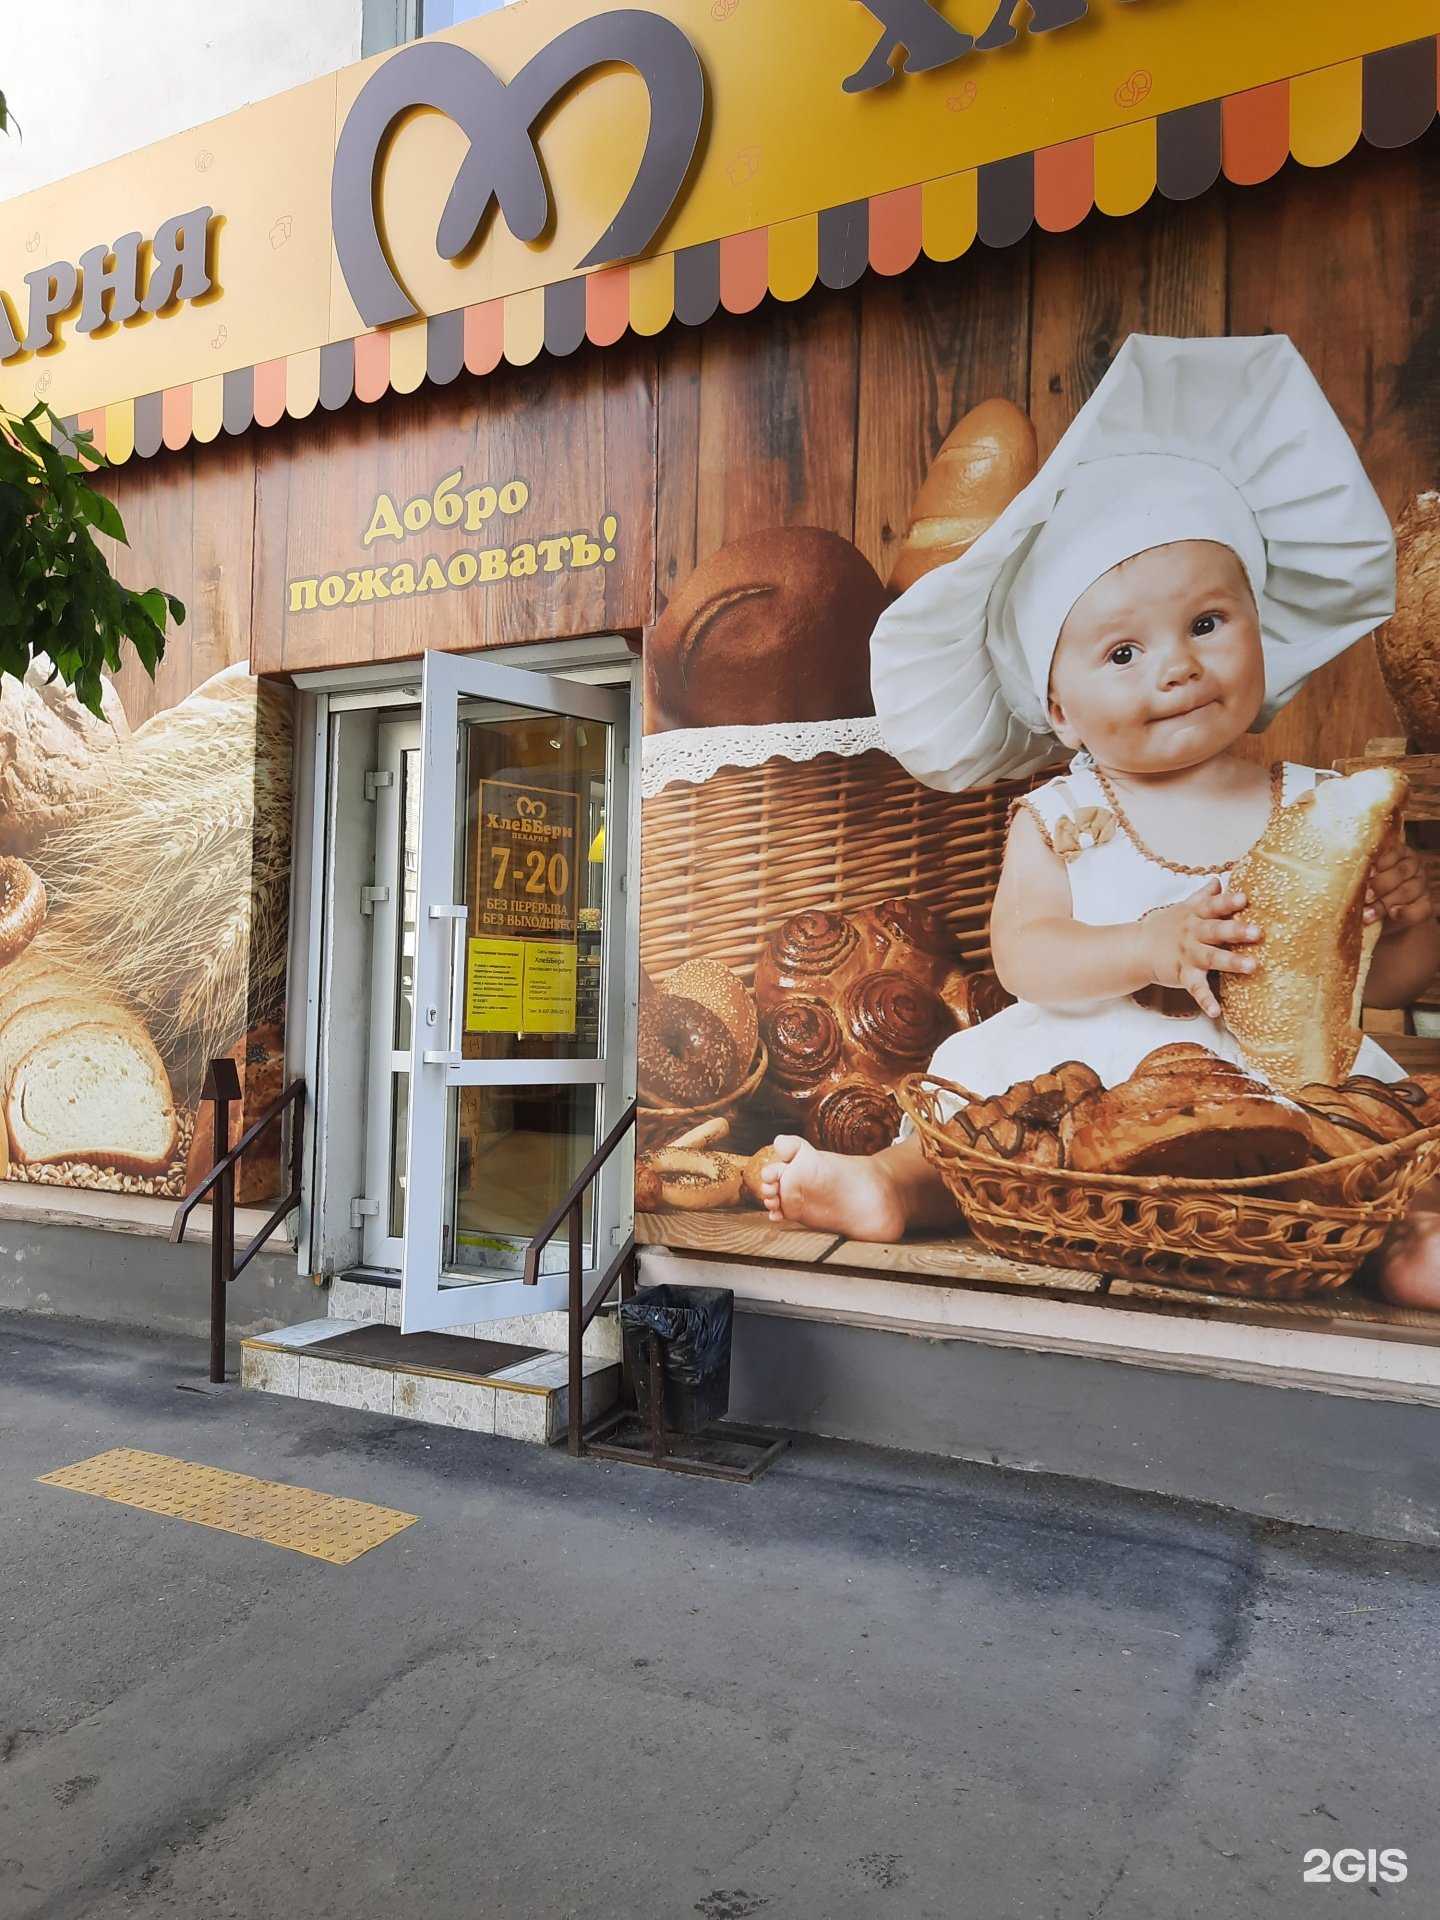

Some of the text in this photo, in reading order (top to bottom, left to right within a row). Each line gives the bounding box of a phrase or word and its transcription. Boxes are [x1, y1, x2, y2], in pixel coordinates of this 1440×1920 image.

[362, 468, 529, 546] Добро
[287, 515, 618, 613] пожаловать!
[491, 847, 569, 896] 7-20
[483, 913, 504, 925] БЕЗ
[486, 898, 567, 916] БЕЗ ПЕРЕРЫВА
